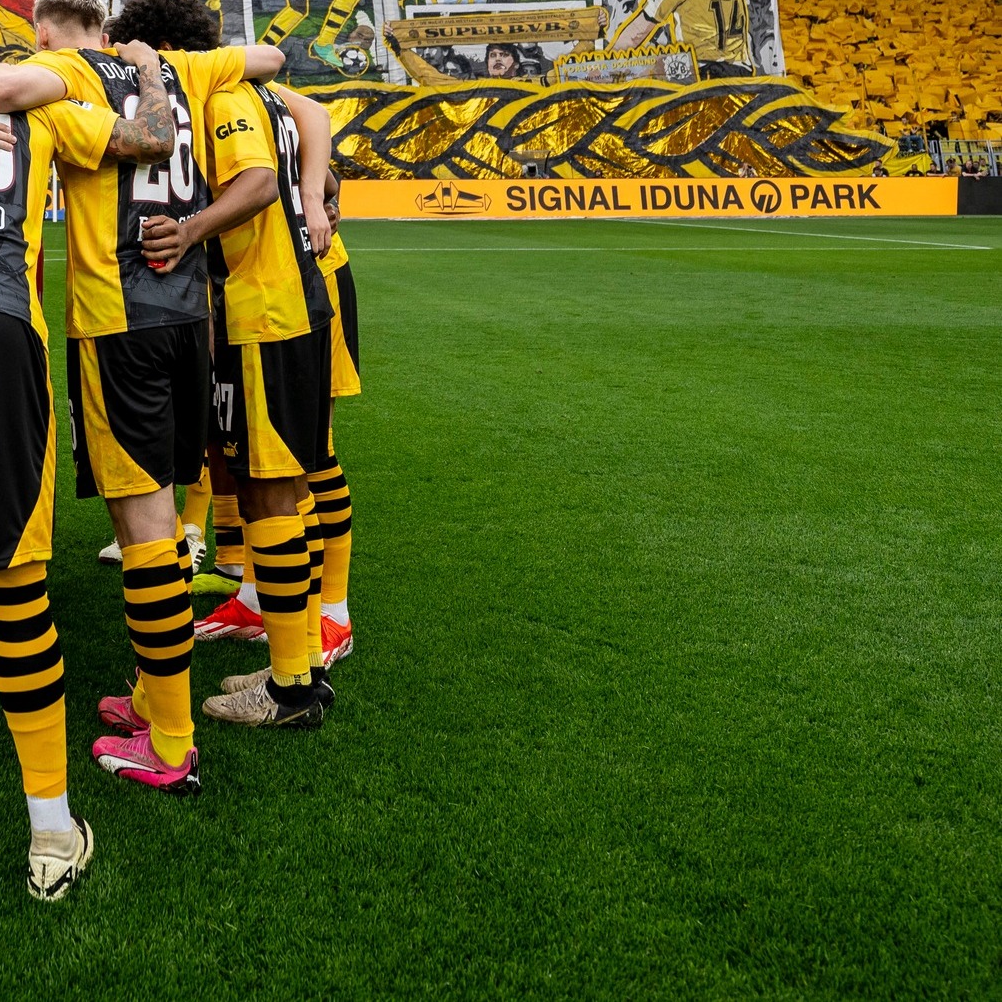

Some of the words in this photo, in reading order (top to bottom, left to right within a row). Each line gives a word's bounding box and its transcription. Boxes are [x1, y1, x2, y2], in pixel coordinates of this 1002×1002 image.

[425, 25, 504, 39] SUPER
[508, 21, 566, 34] B.V.B.
[709, 0, 745, 50] 14
[612, 58, 657, 70] DORTMUND
[215, 118, 255, 140] GLS.
[506, 185, 632, 211] SIGNAL
[639, 184, 745, 210] IDUNA
[789, 184, 882, 210] PARK
